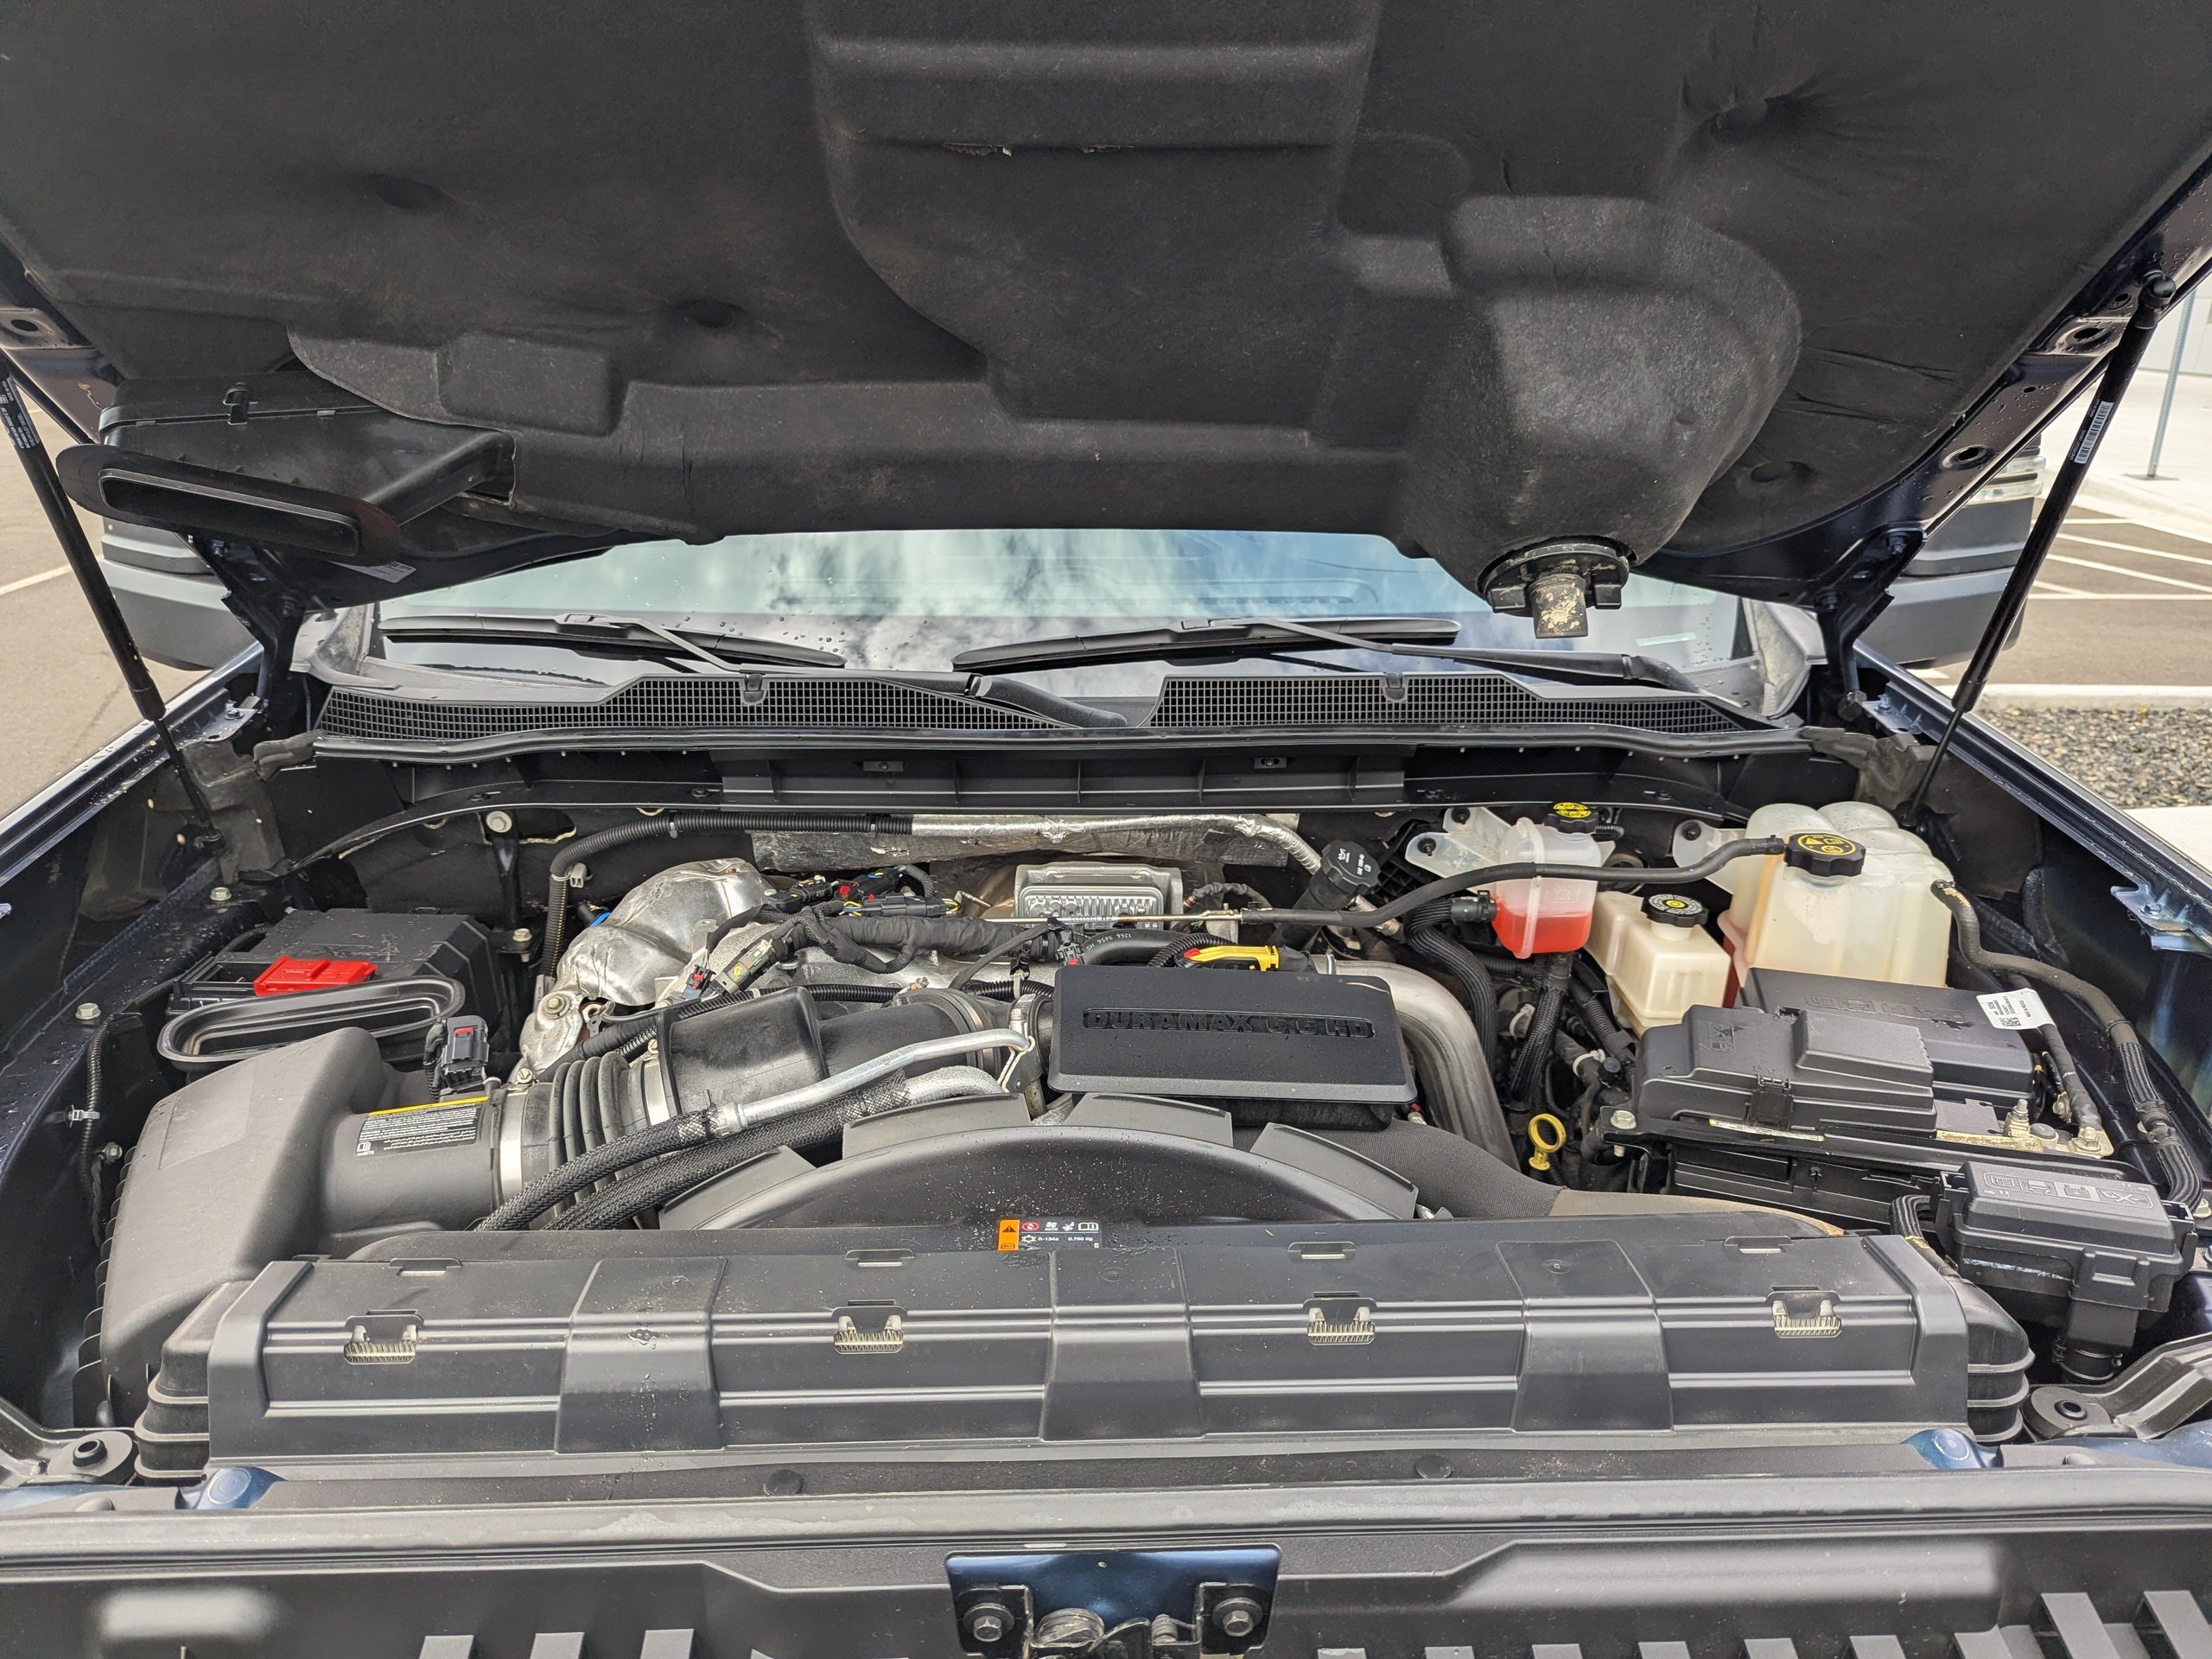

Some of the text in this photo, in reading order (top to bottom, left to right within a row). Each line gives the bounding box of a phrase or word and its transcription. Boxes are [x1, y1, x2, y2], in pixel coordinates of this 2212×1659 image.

[1087, 1011, 1372, 1038] DURAMAX 6.6 HD
